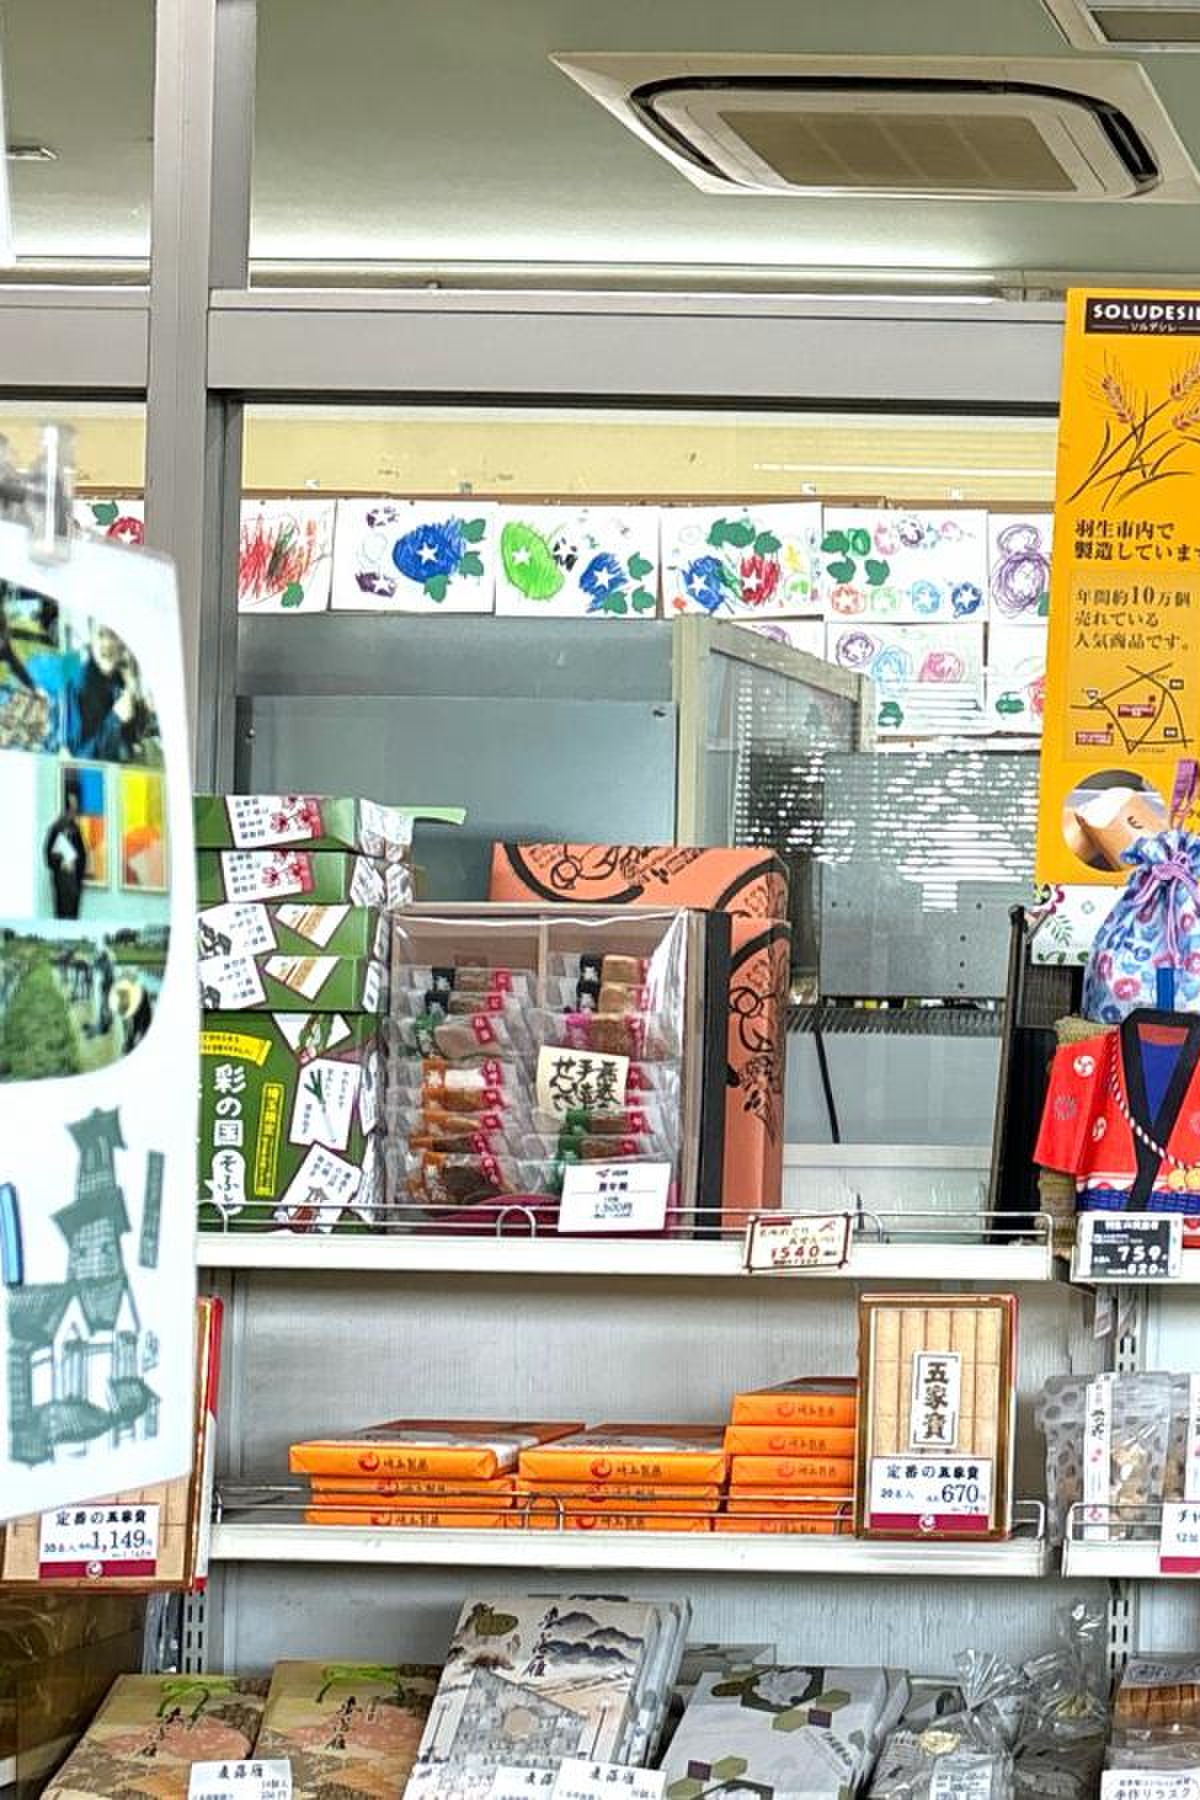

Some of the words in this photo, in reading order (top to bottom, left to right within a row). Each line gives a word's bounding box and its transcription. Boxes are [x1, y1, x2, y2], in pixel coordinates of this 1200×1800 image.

[1075, 519, 1174, 540] 羽生市内で
[1076, 586, 1191, 607] 年間約10万個
[1075, 610, 1160, 627] 売れている
[1074, 633, 1189, 651] 人気商品です。
[213, 1064, 246, 1147] 彩の国
[942, 1484, 979, 1503] 670
[92, 1529, 146, 1552] 1,149
